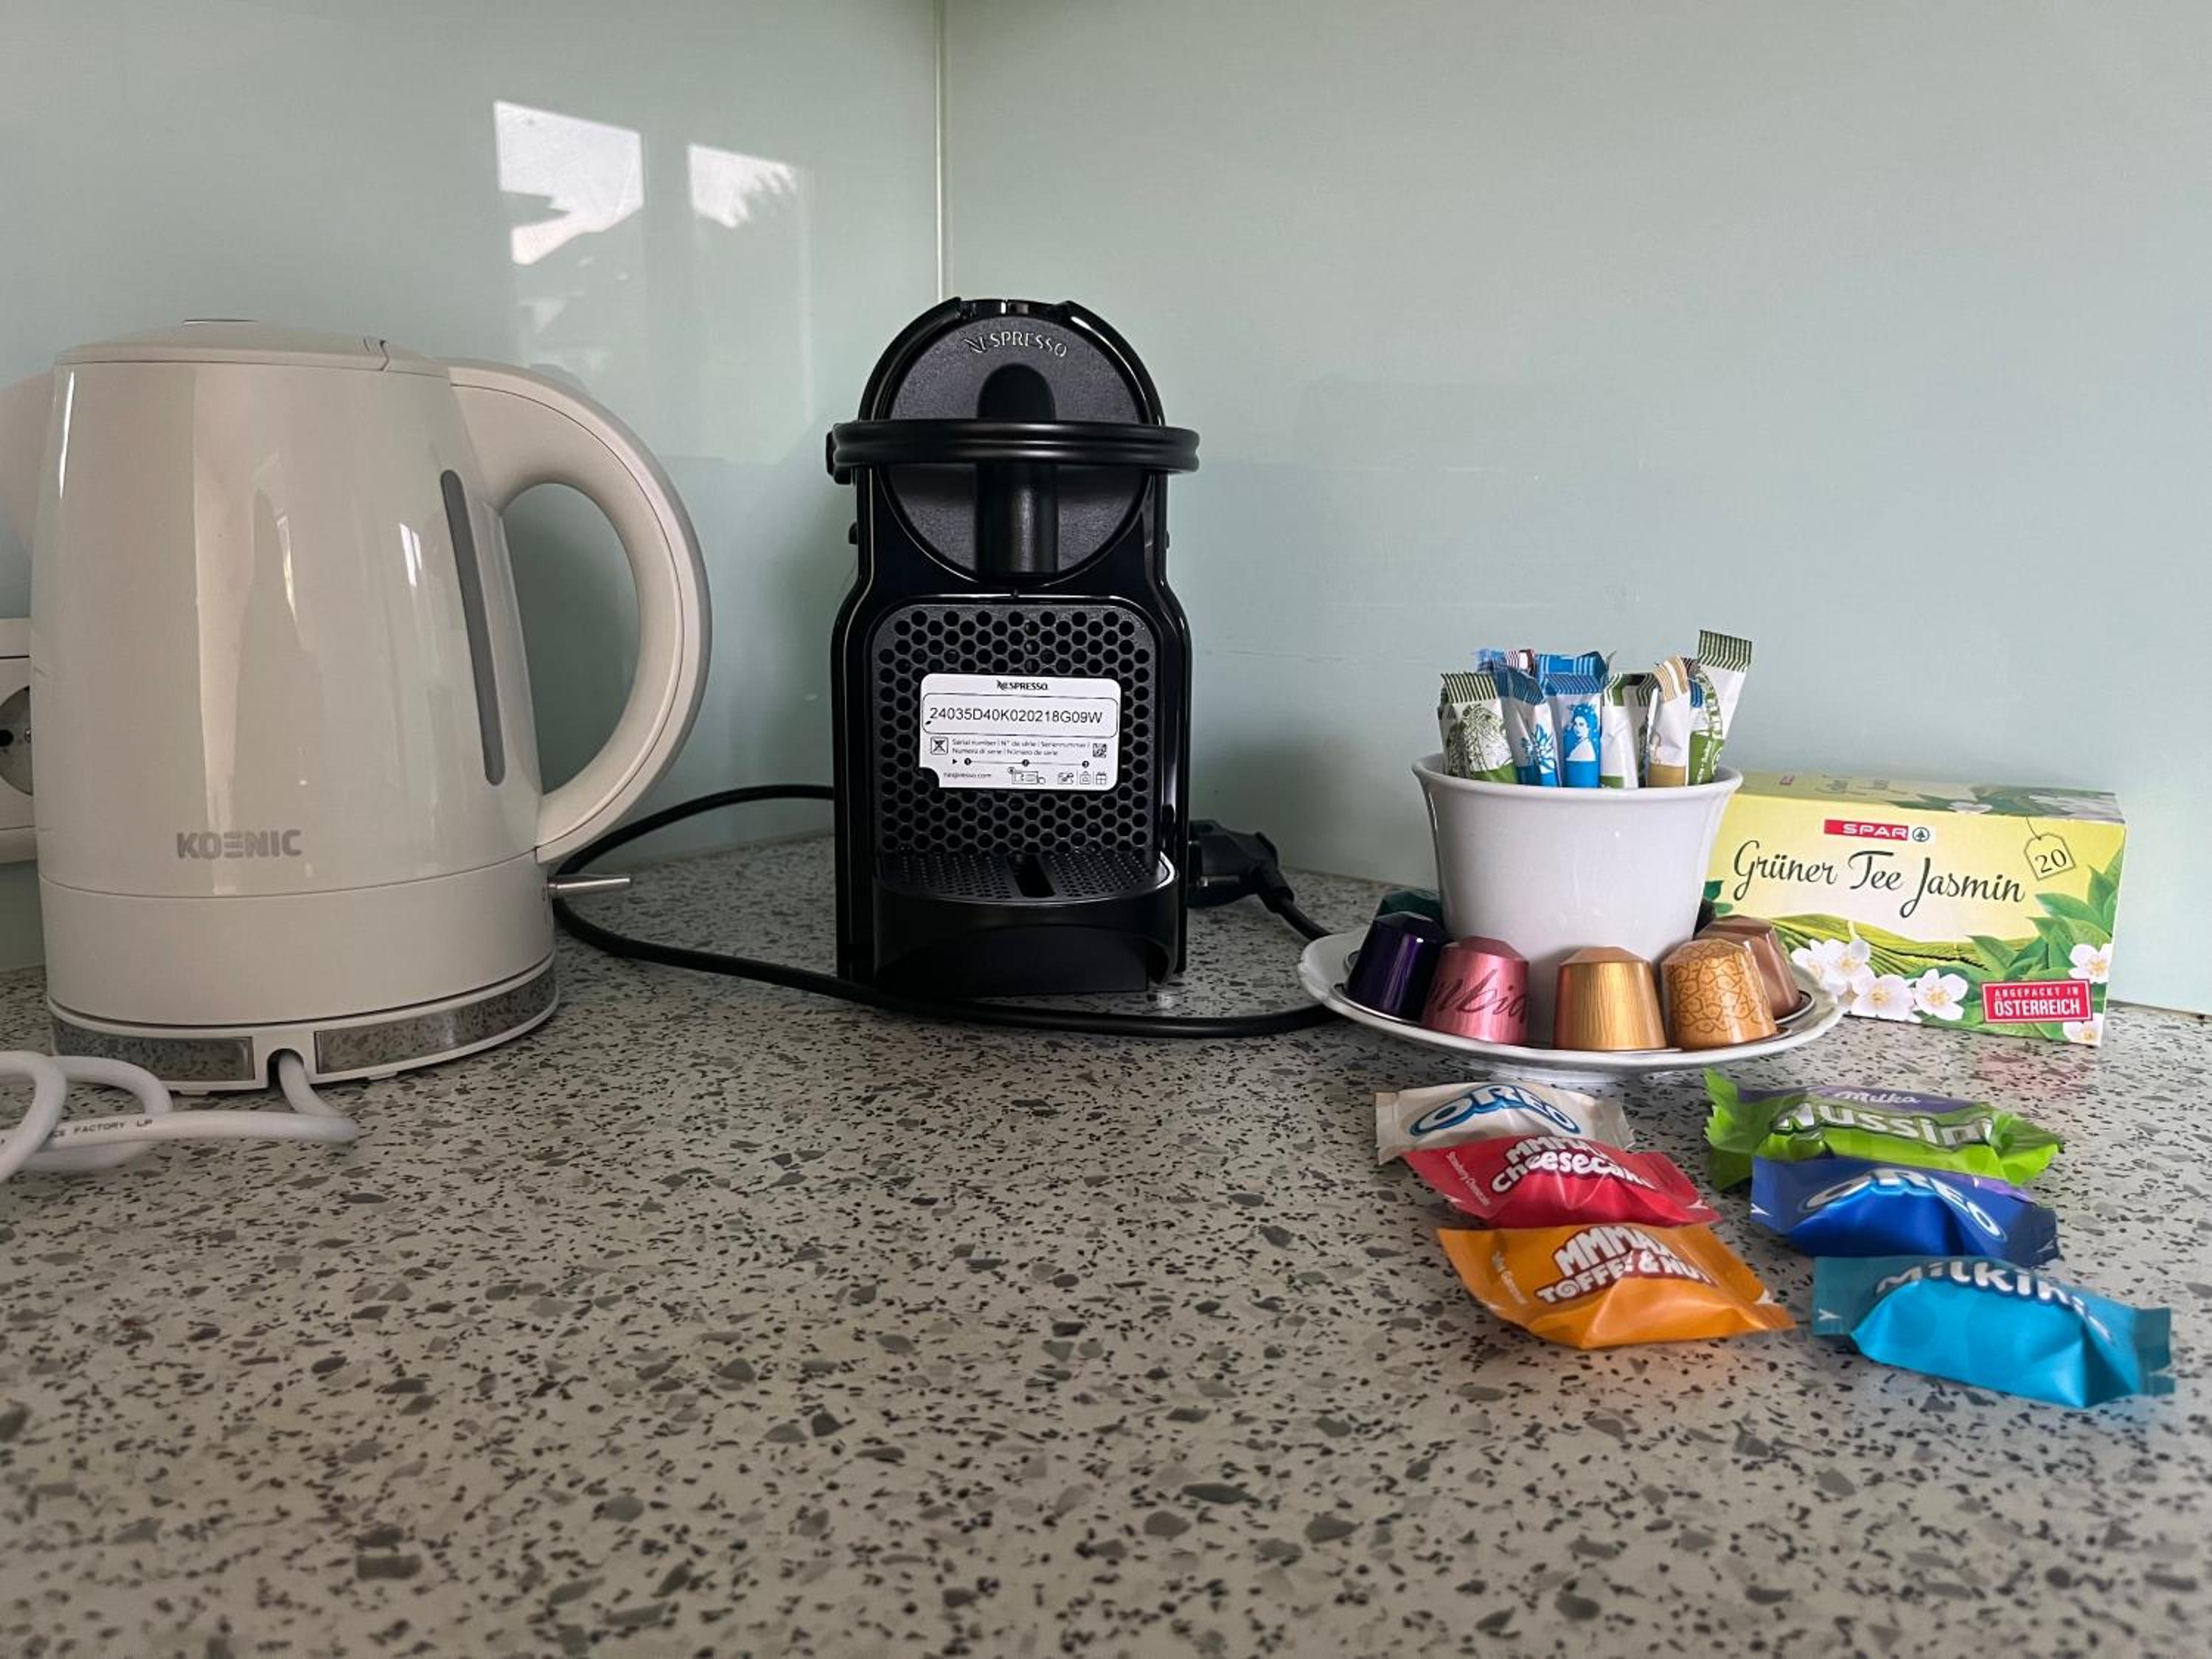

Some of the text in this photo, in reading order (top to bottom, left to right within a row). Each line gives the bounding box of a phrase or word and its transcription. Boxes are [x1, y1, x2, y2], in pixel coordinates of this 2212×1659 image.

[962, 331, 1068, 358] NESPRESSO
[996, 681, 1048, 690] NESPRESSO
[929, 707, 1103, 724] 24035D40K020218G09W
[1842, 823, 1908, 838] SPAR
[176, 830, 303, 859] KOENIC
[2034, 849, 2067, 874] 20
[1733, 840, 2025, 919] Grüner Tee Jasmin
[1994, 987, 2079, 998] ABGEPACKT IN
[1994, 998, 2081, 1016] ÖSTERREICH
[1837, 1091, 1921, 1104] Milka
[1410, 1084, 1581, 1136] OREO
[74, 1121, 126, 1133] FACTORY
[1801, 1168, 2006, 1242] OREO
